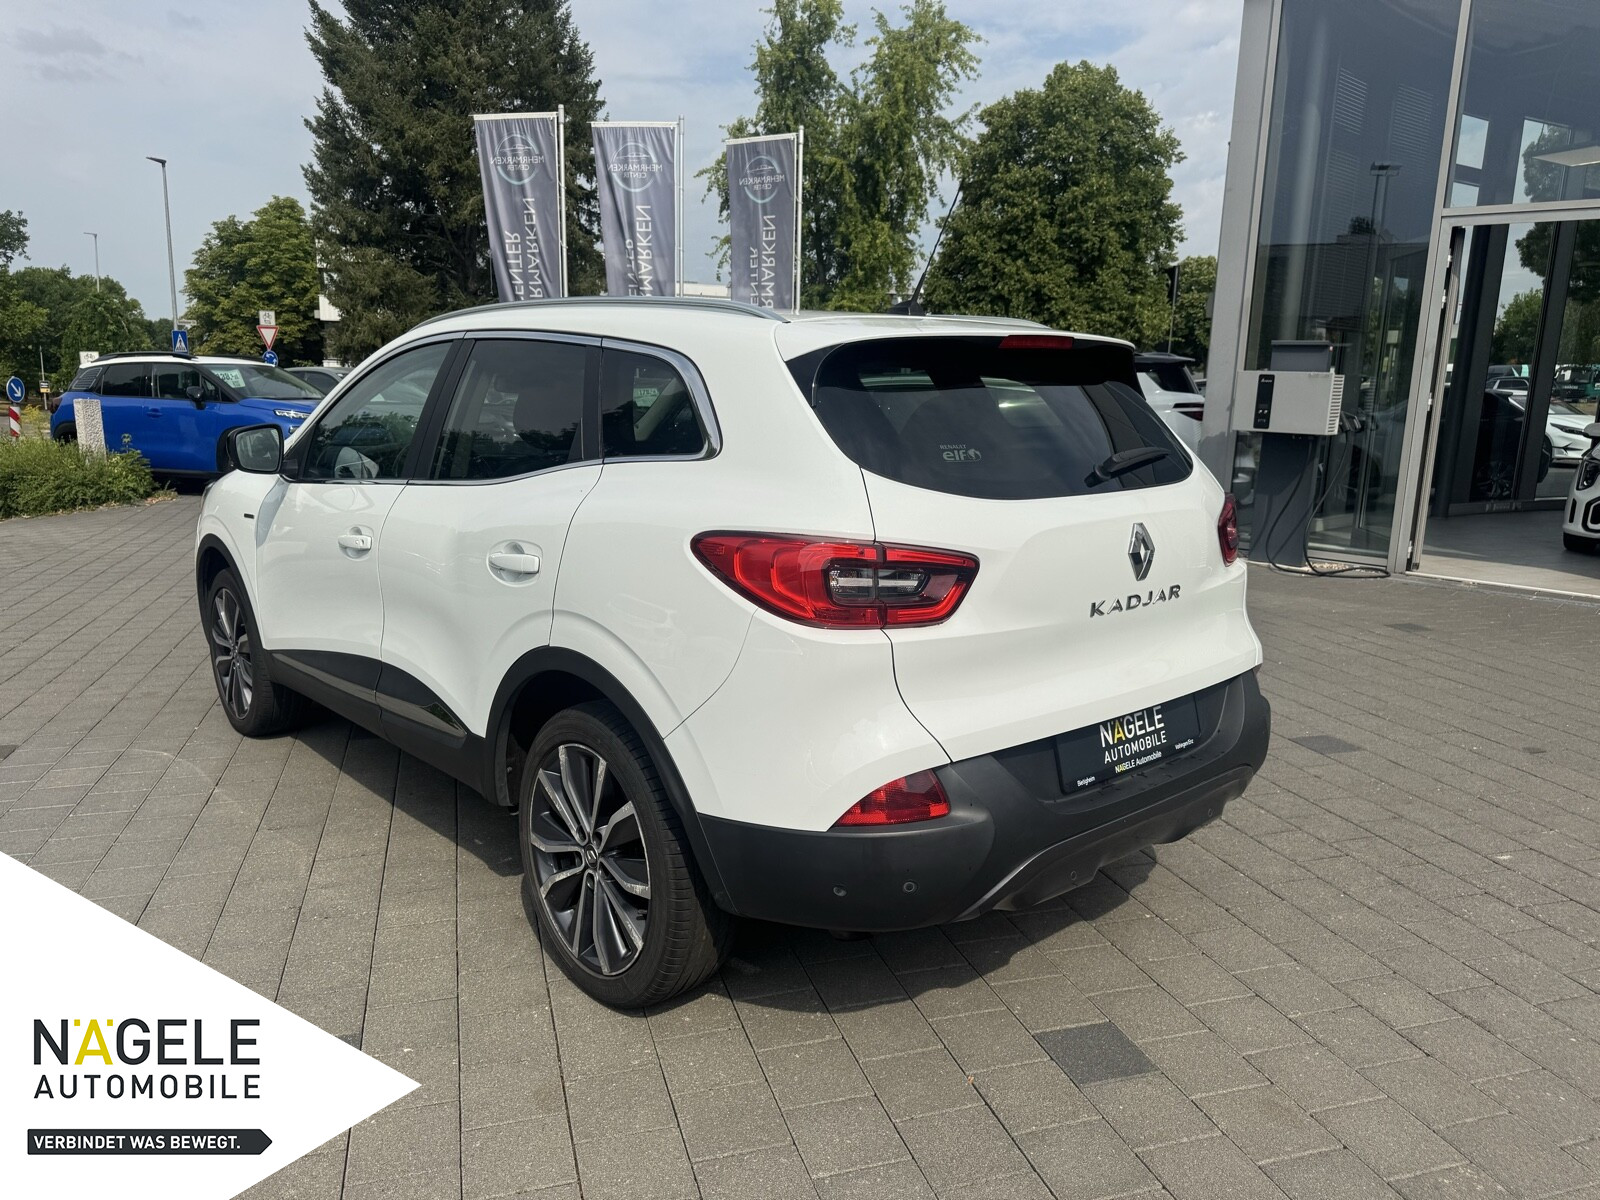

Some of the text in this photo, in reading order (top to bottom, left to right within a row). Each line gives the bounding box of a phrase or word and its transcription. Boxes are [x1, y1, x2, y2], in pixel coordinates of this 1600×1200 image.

[942, 449, 967, 461] elf
[1089, 584, 1181, 618] KADJAR
[1100, 705, 1165, 748] NÄGELE
[1104, 730, 1168, 765] AUTOMOBILE
[1135, 750, 1162, 767] Automobile
